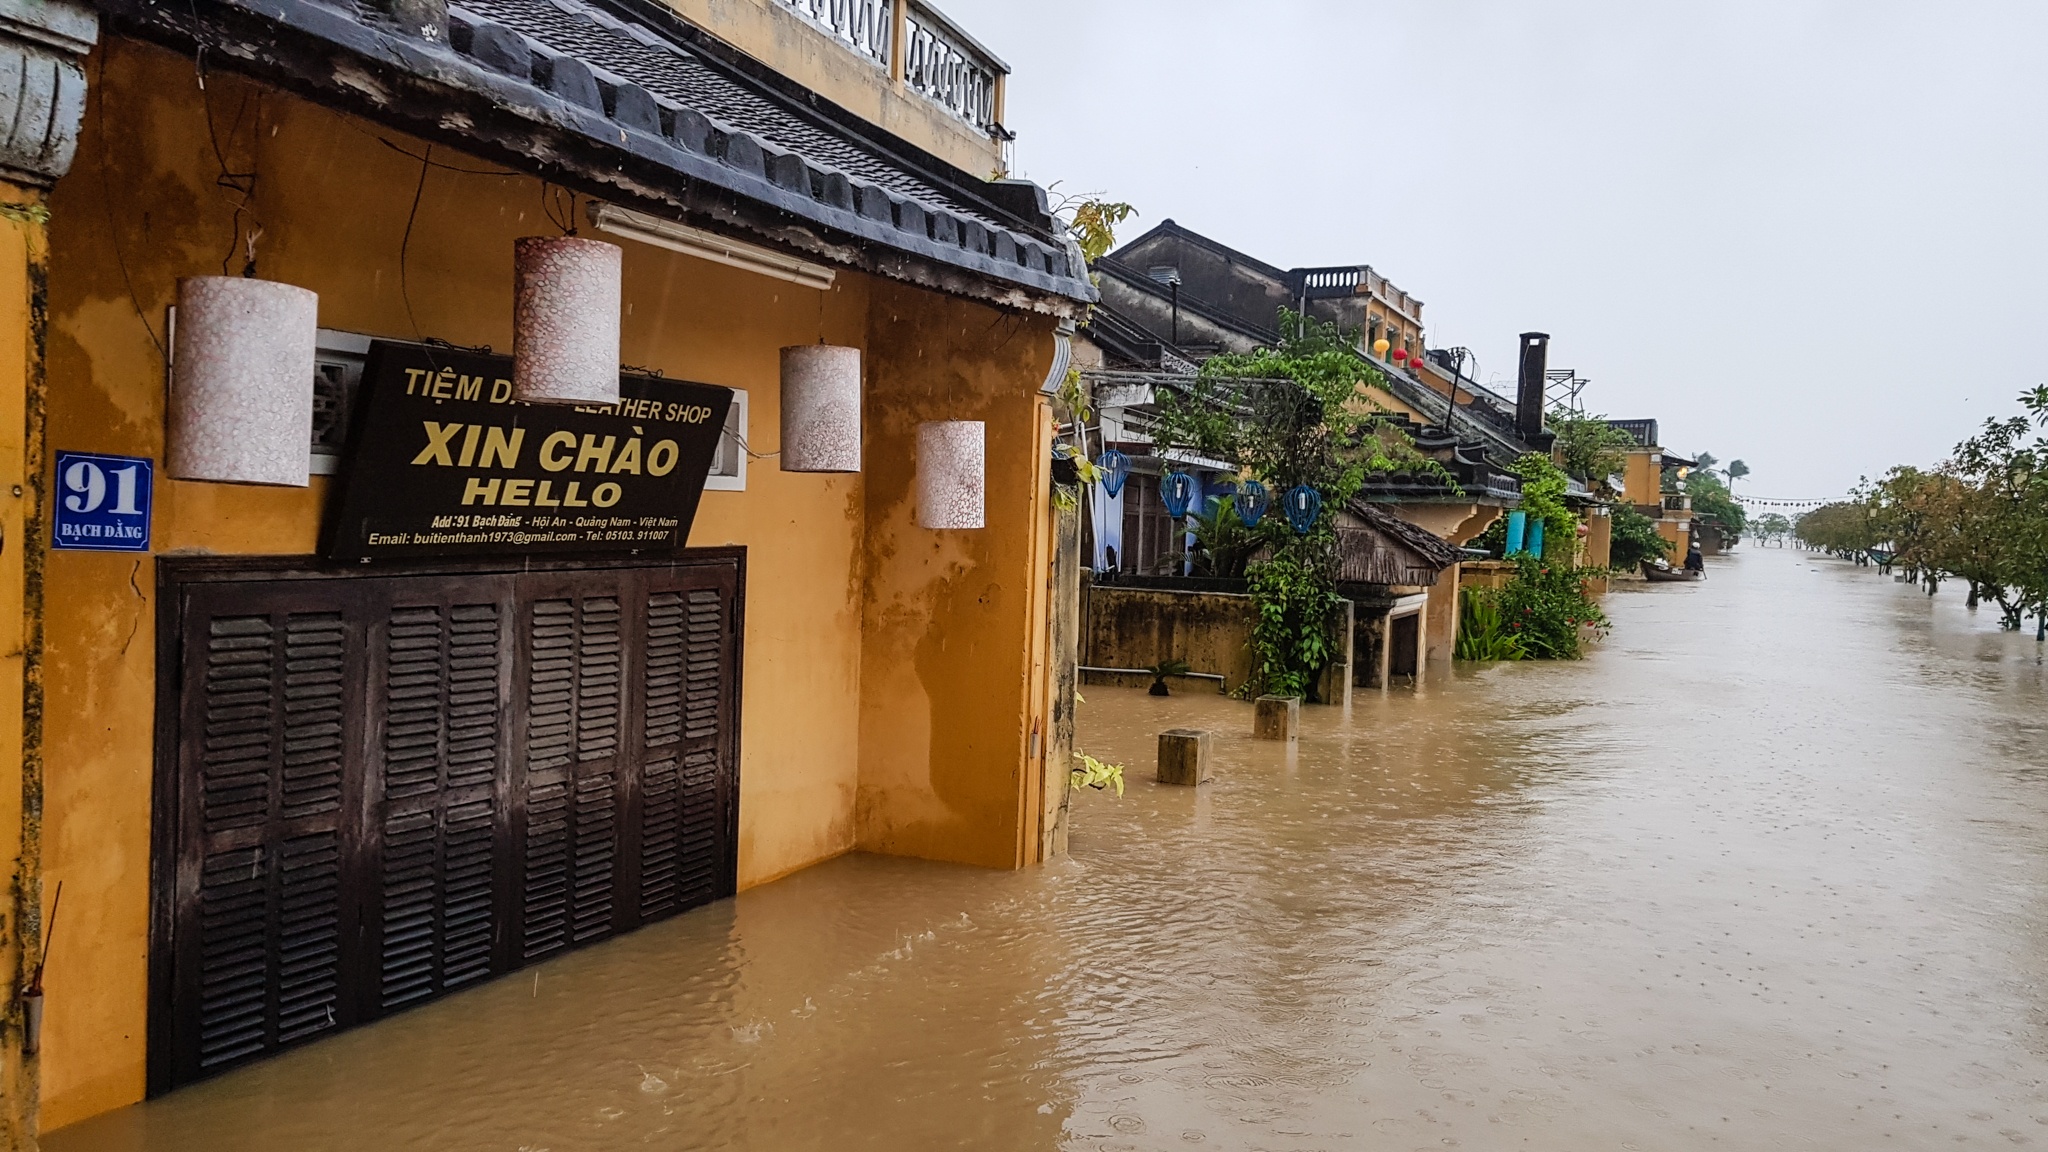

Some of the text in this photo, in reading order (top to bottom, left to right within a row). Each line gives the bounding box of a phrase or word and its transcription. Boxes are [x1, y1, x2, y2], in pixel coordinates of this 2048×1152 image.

[405, 366, 484, 404] TIỆM
[665, 403, 712, 424] SHOP
[410, 420, 679, 477] XIN CHÀO
[64, 461, 143, 515] 91
[461, 478, 622, 508] HELLO
[61, 523, 102, 541] BẠCH
[368, 532, 411, 545] Email:
[413, 530, 577, 545] buitienthanh1973@gmail.com
[586, 530, 604, 541] Tel:
[637, 530, 669, 541] 911007
[531, 516, 550, 530] Hội
[551, 516, 566, 527] An
[575, 515, 608, 529] Quảng
[609, 517, 631, 527] Nam
[639, 517, 658, 528] Việt
[657, 517, 678, 527] Nam
